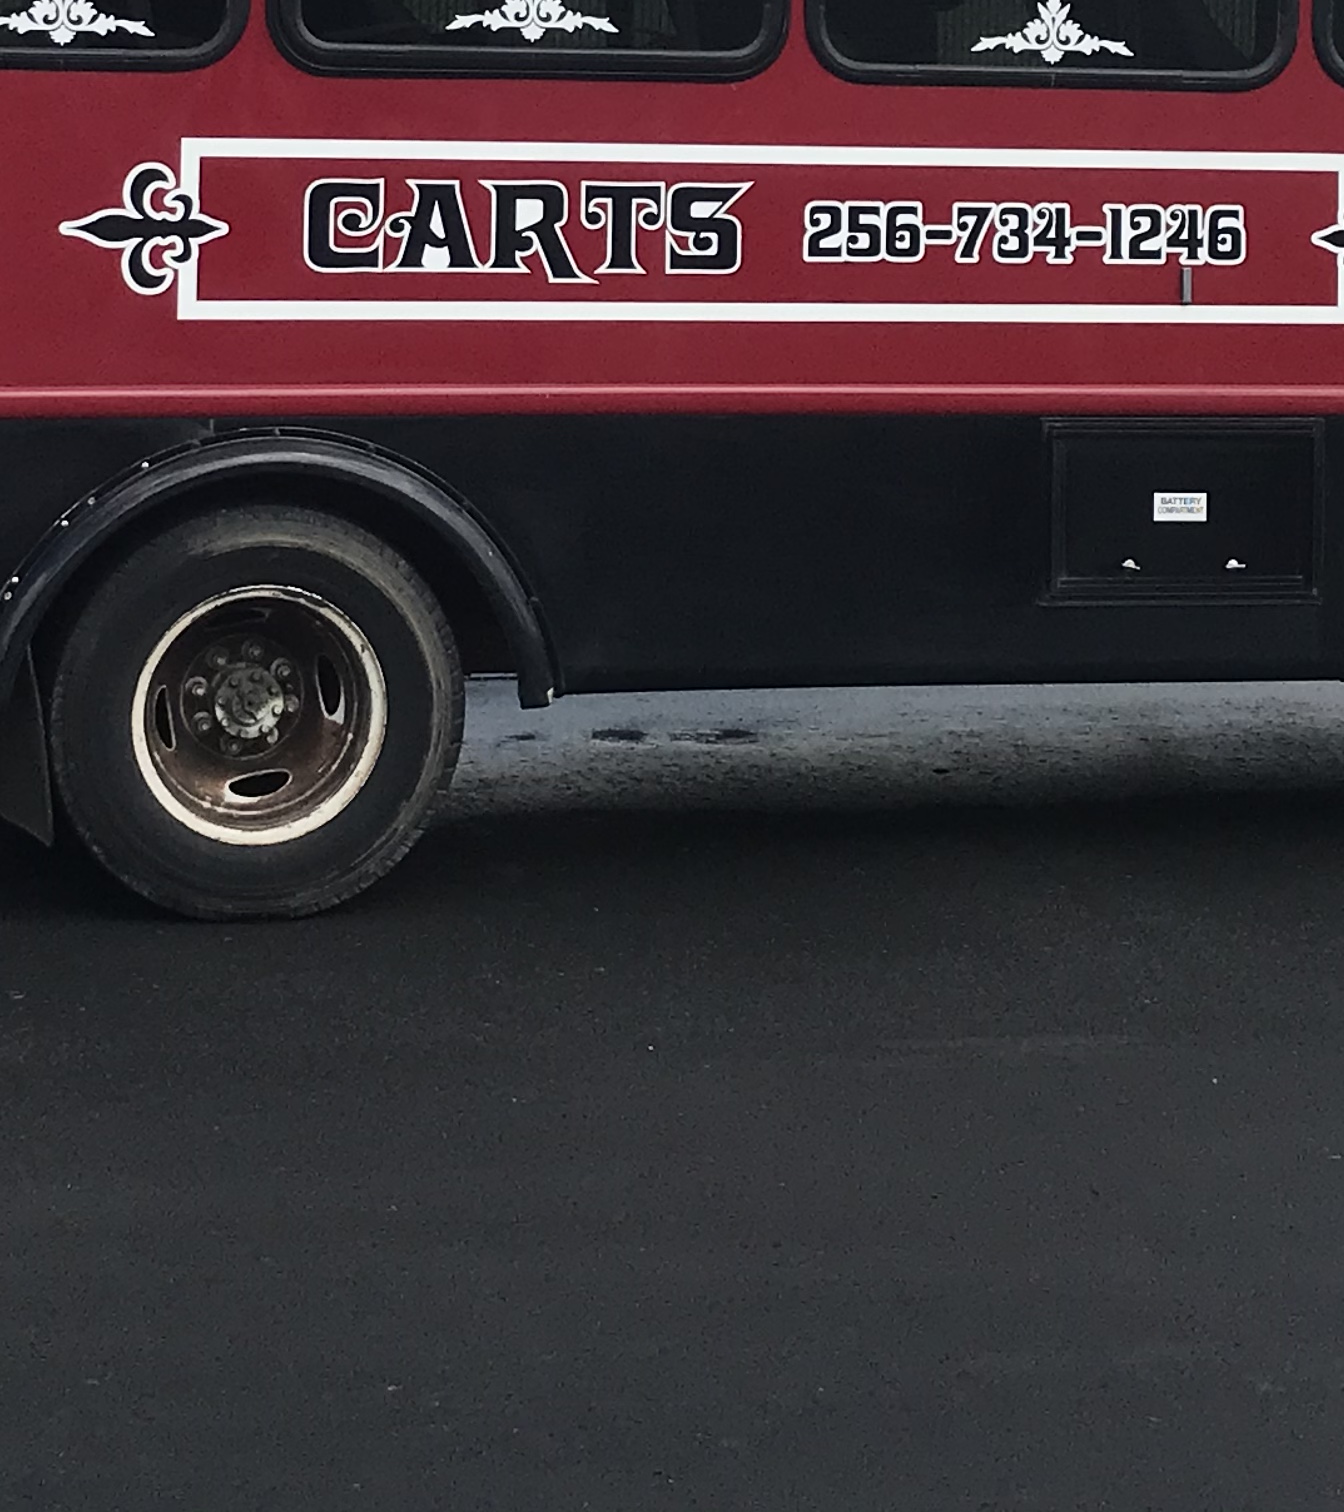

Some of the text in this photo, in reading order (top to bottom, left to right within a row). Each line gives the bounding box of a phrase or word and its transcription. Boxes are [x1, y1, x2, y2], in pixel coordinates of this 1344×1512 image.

[303, 177, 1247, 284] CARTS 256-734-1246
[1160, 497, 1202, 505] BATTERY
